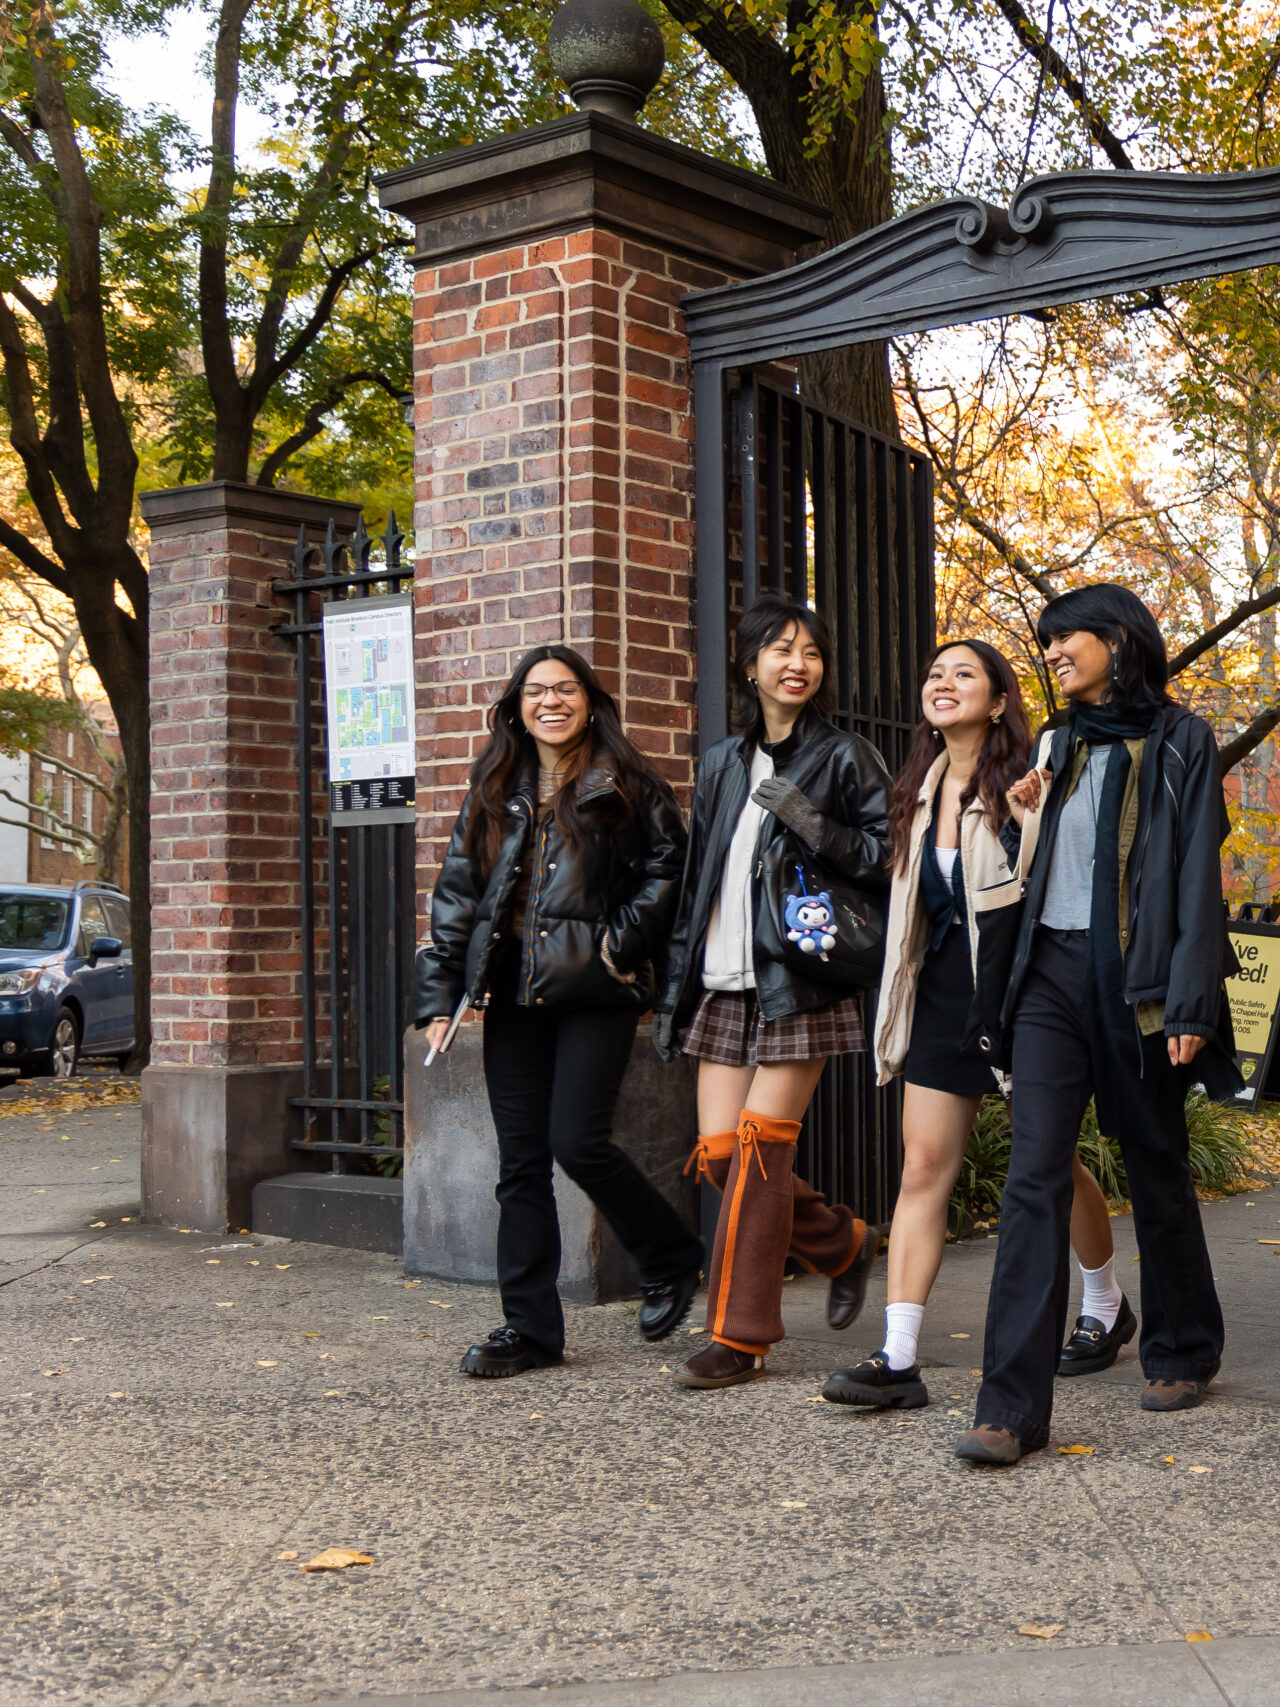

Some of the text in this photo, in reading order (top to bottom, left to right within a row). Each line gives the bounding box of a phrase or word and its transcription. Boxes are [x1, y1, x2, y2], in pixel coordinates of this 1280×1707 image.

[1235, 940, 1258, 961] 've
[1230, 998, 1266, 1009] Public Safety
[1236, 1008, 1257, 1017] Chapel
